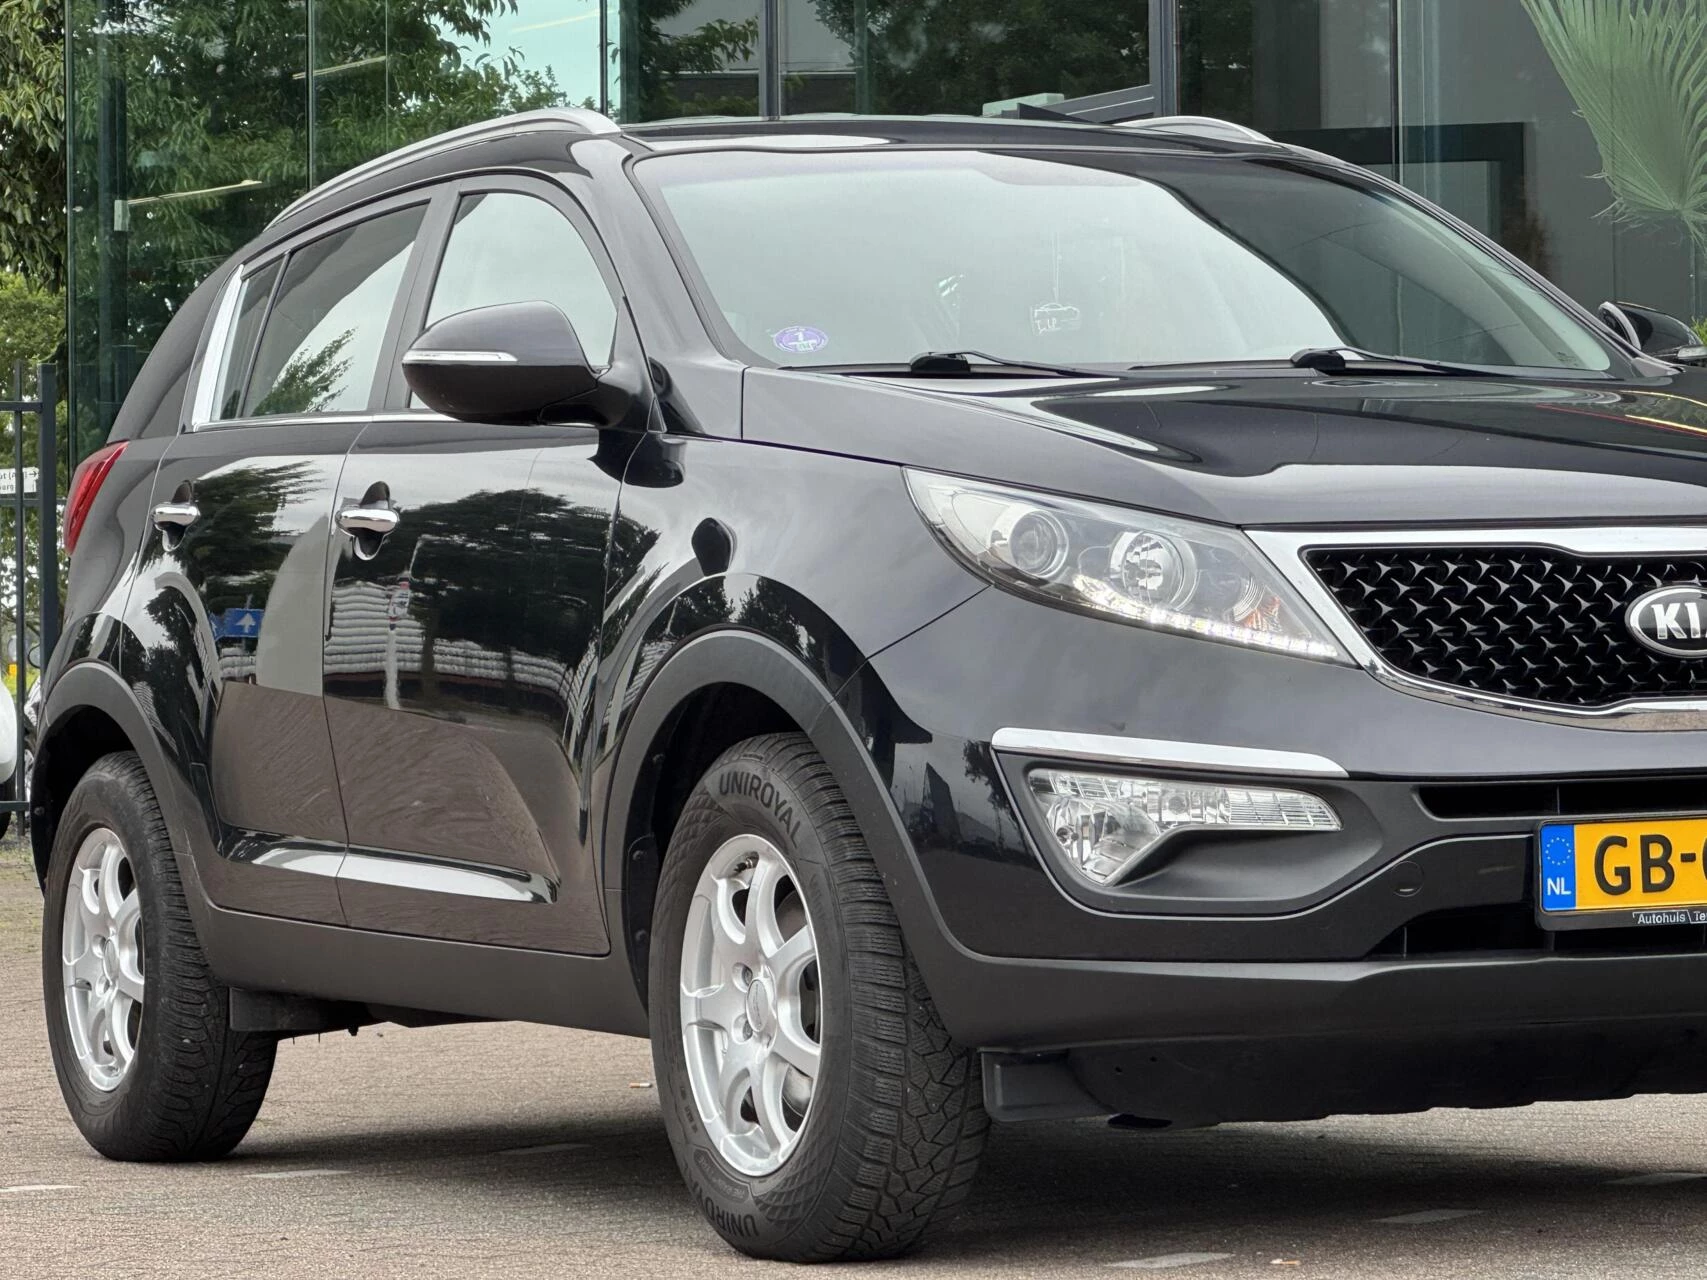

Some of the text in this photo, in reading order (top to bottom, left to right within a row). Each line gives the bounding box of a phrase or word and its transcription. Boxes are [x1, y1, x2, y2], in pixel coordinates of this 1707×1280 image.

[1651, 602, 1707, 640] KI
[719, 771, 801, 849] UNIROYAL
[1594, 834, 1707, 896] GB-
[1547, 877, 1571, 896] NL
[1637, 910, 1707, 925] Autohuis Te
